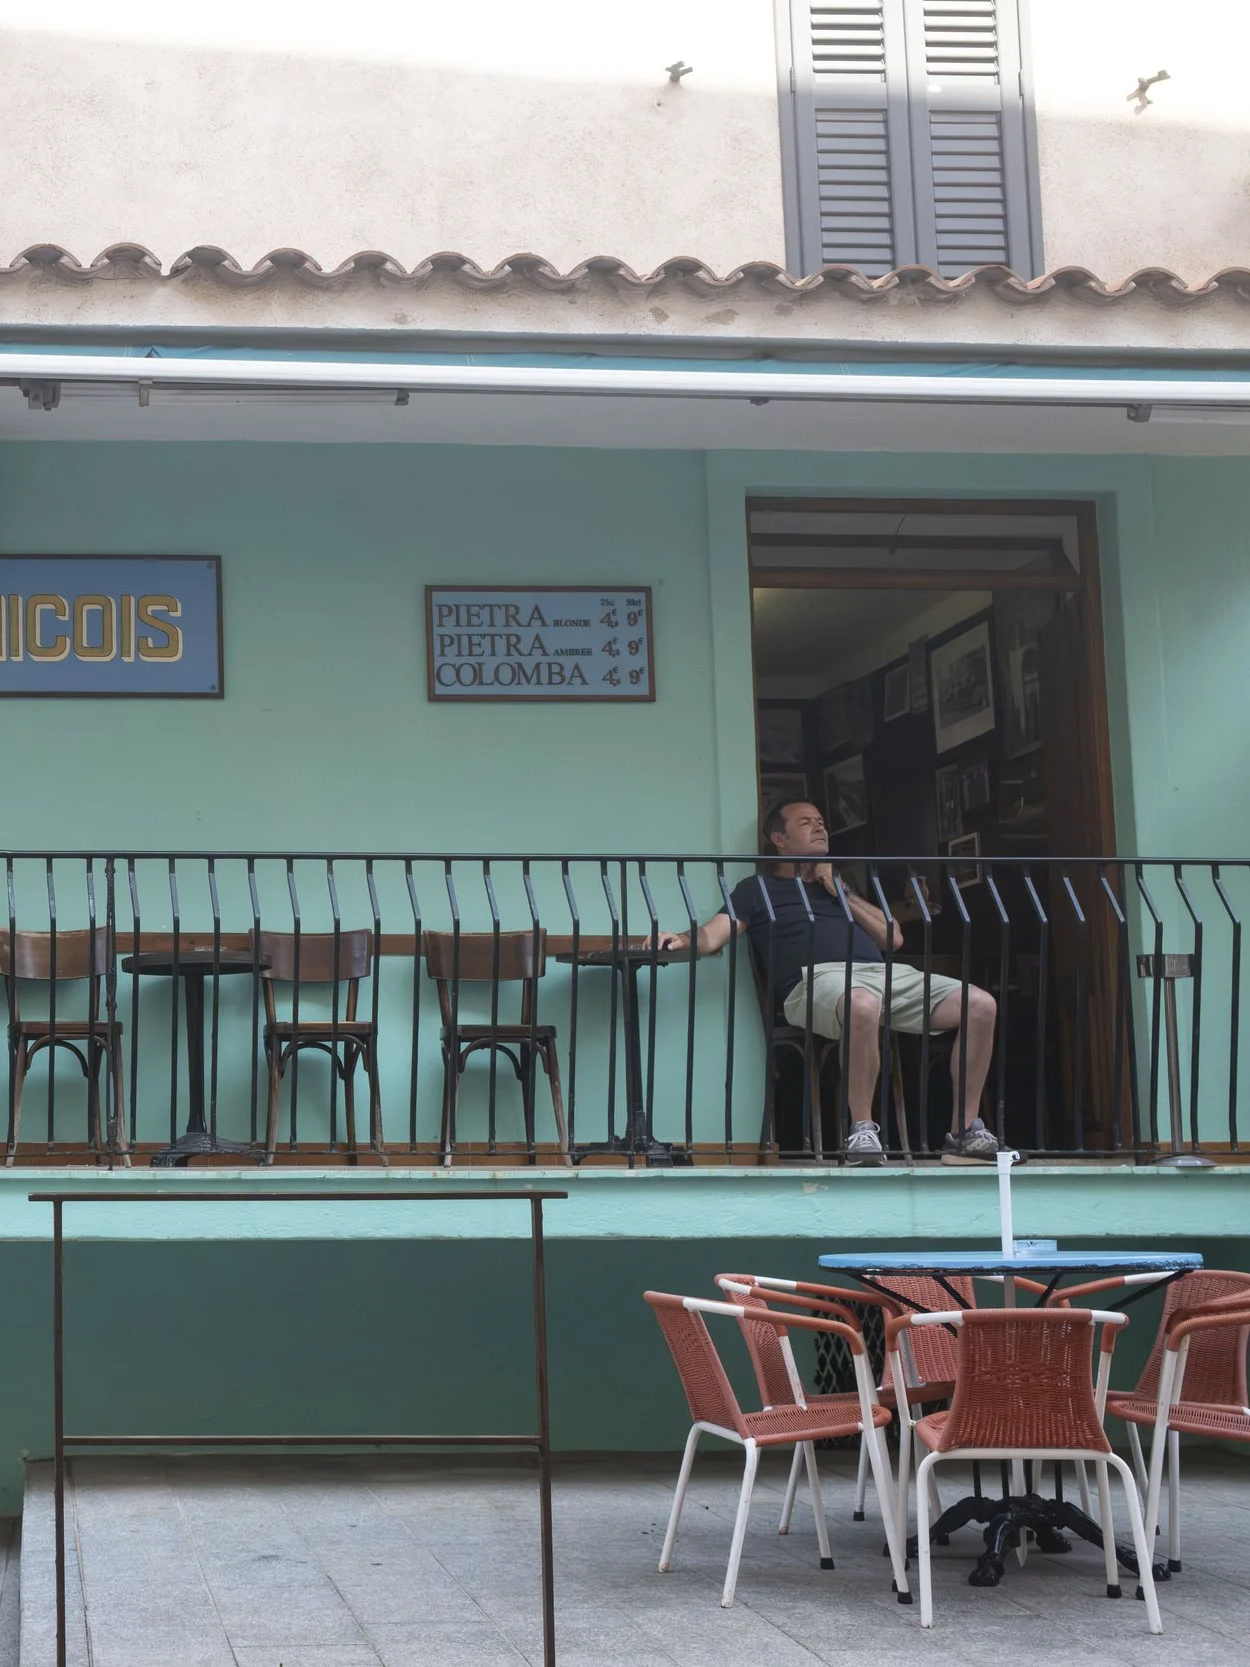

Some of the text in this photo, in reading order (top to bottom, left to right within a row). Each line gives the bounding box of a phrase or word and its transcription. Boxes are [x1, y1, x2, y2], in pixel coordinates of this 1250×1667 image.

[436, 604, 549, 628] PIETRA
[553, 619, 591, 627] BLONDE
[436, 633, 550, 657] PIETRA
[436, 662, 591, 687] COLOMBA
